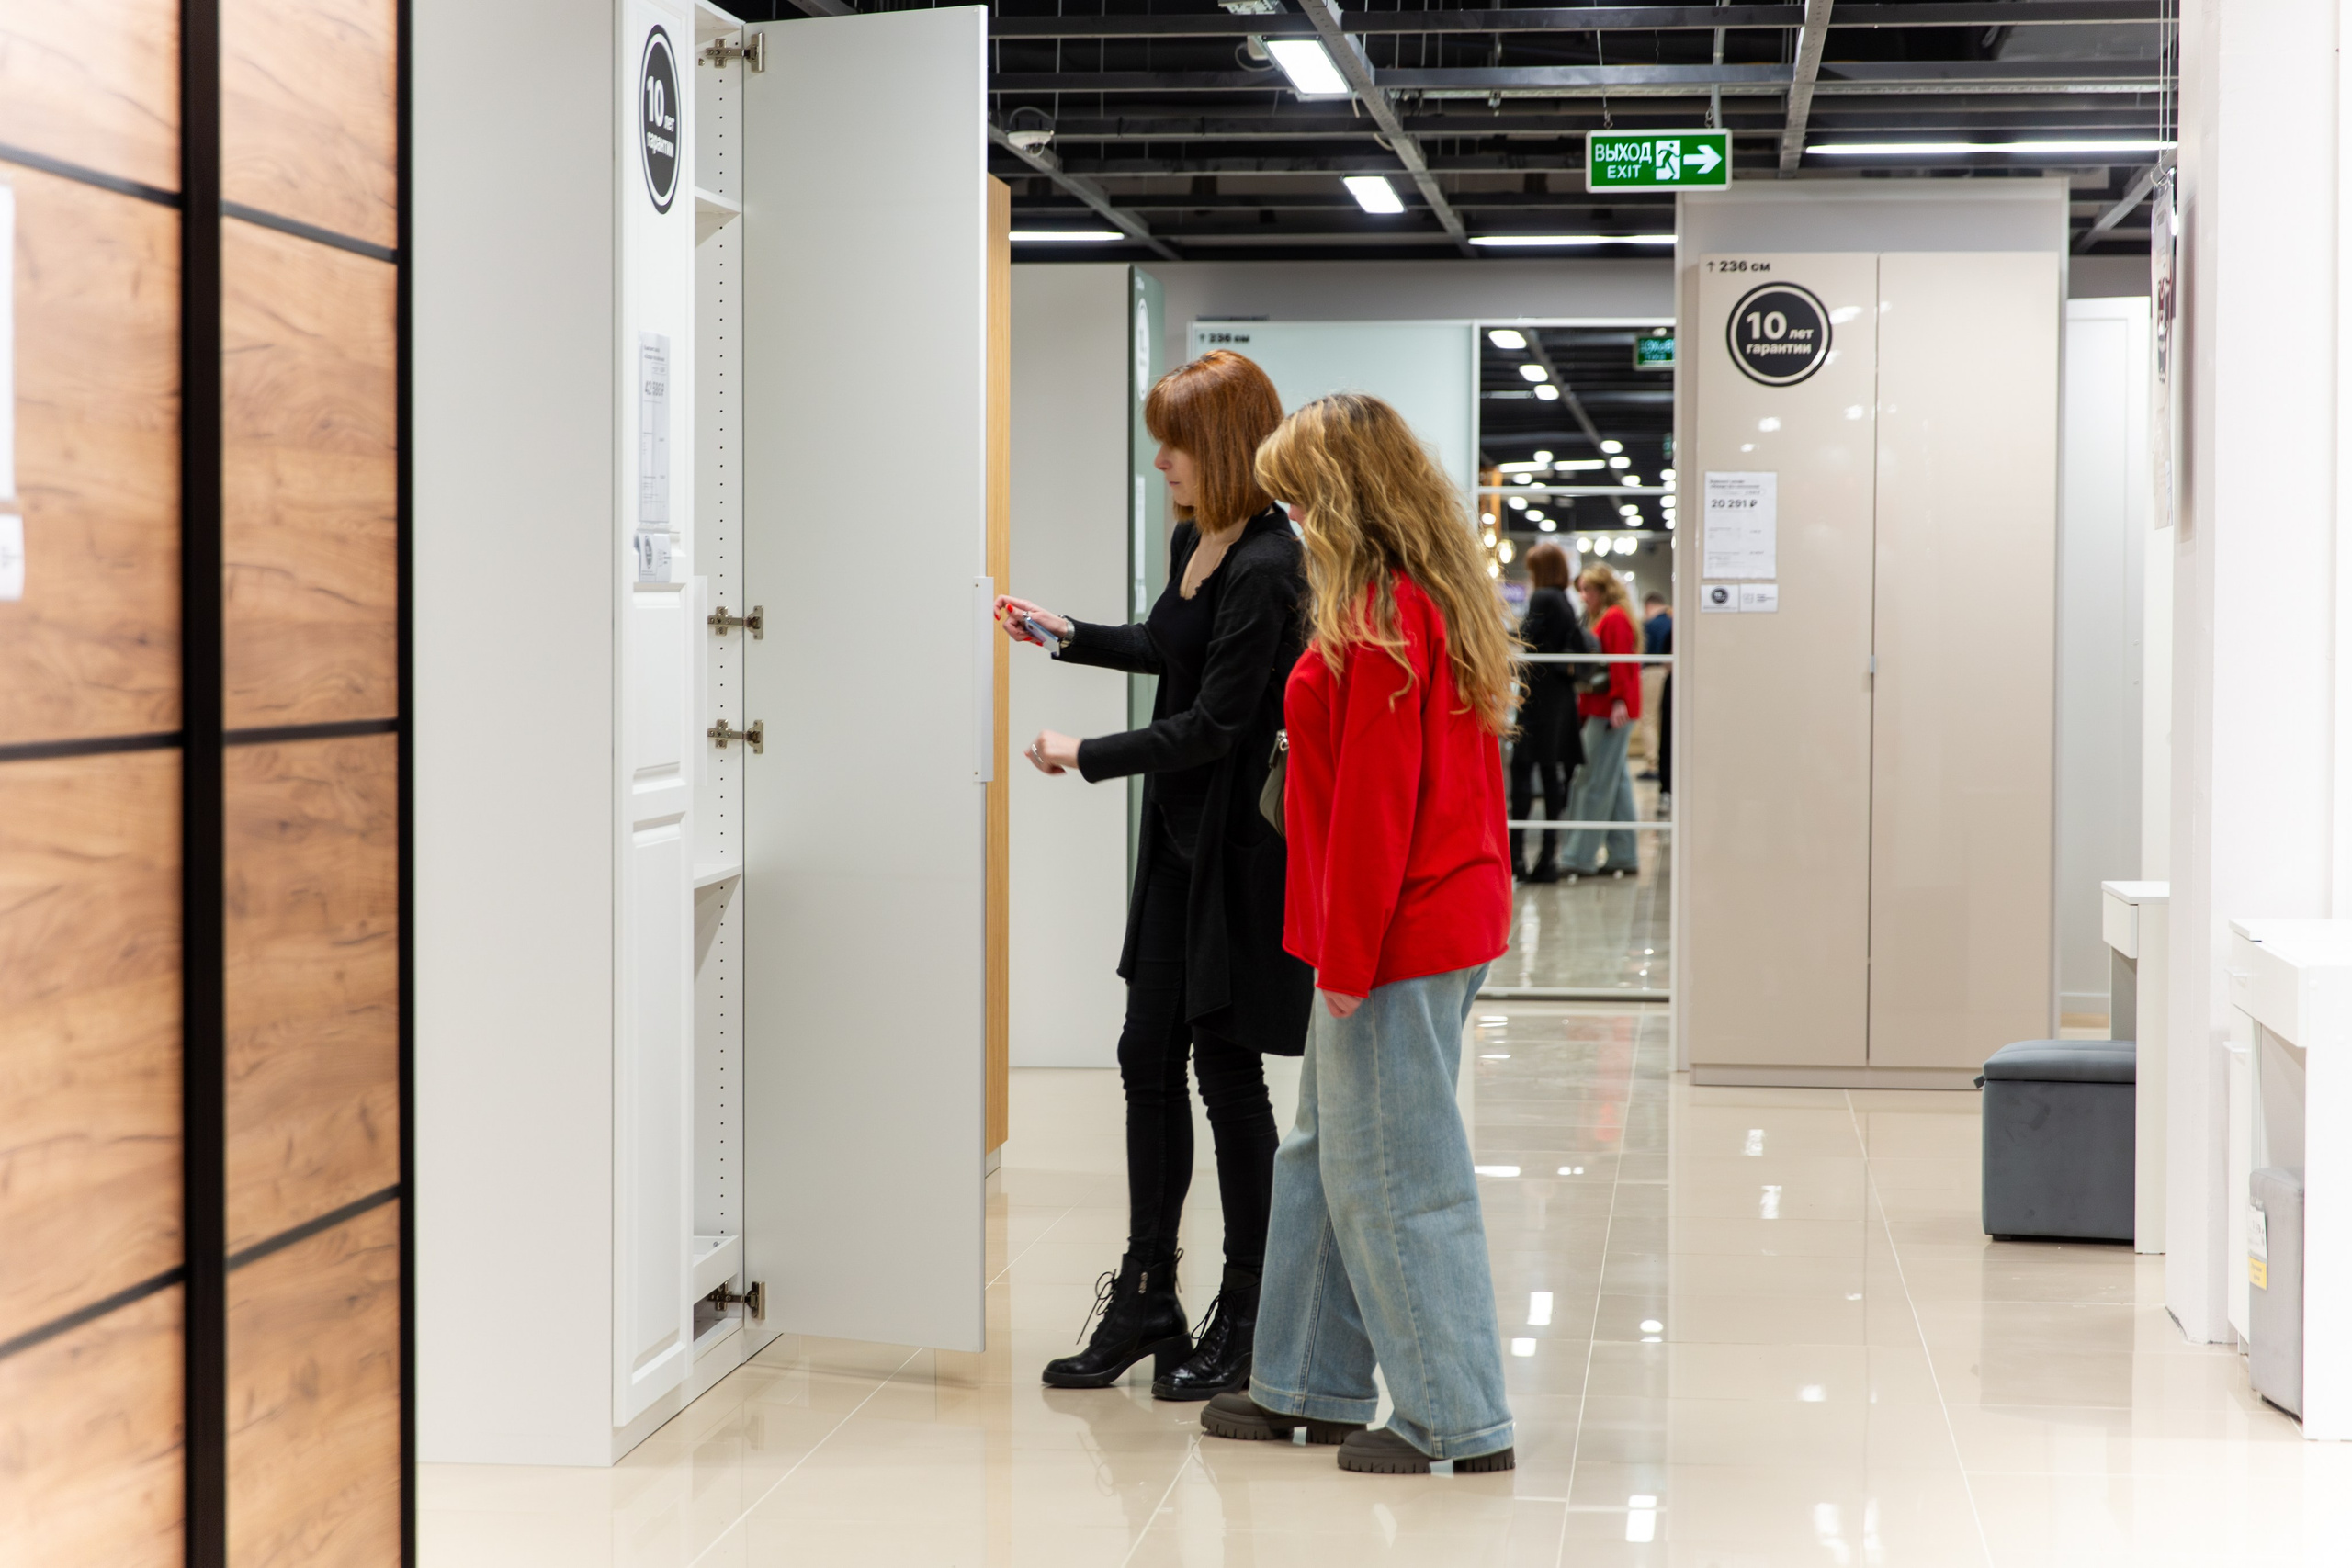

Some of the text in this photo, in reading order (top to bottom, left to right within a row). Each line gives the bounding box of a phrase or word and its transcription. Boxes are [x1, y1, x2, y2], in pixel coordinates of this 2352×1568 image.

[646, 75, 675, 132] 10 лет
[646, 131, 674, 158] гарантии
[1594, 141, 1653, 164] ВЫХОД
[1607, 164, 1642, 179] EXIT
[1719, 260, 1770, 272] 236 см
[1747, 311, 1815, 340] 10 лет
[1747, 343, 1813, 357] гарантии
[1712, 499, 1725, 508] 20
